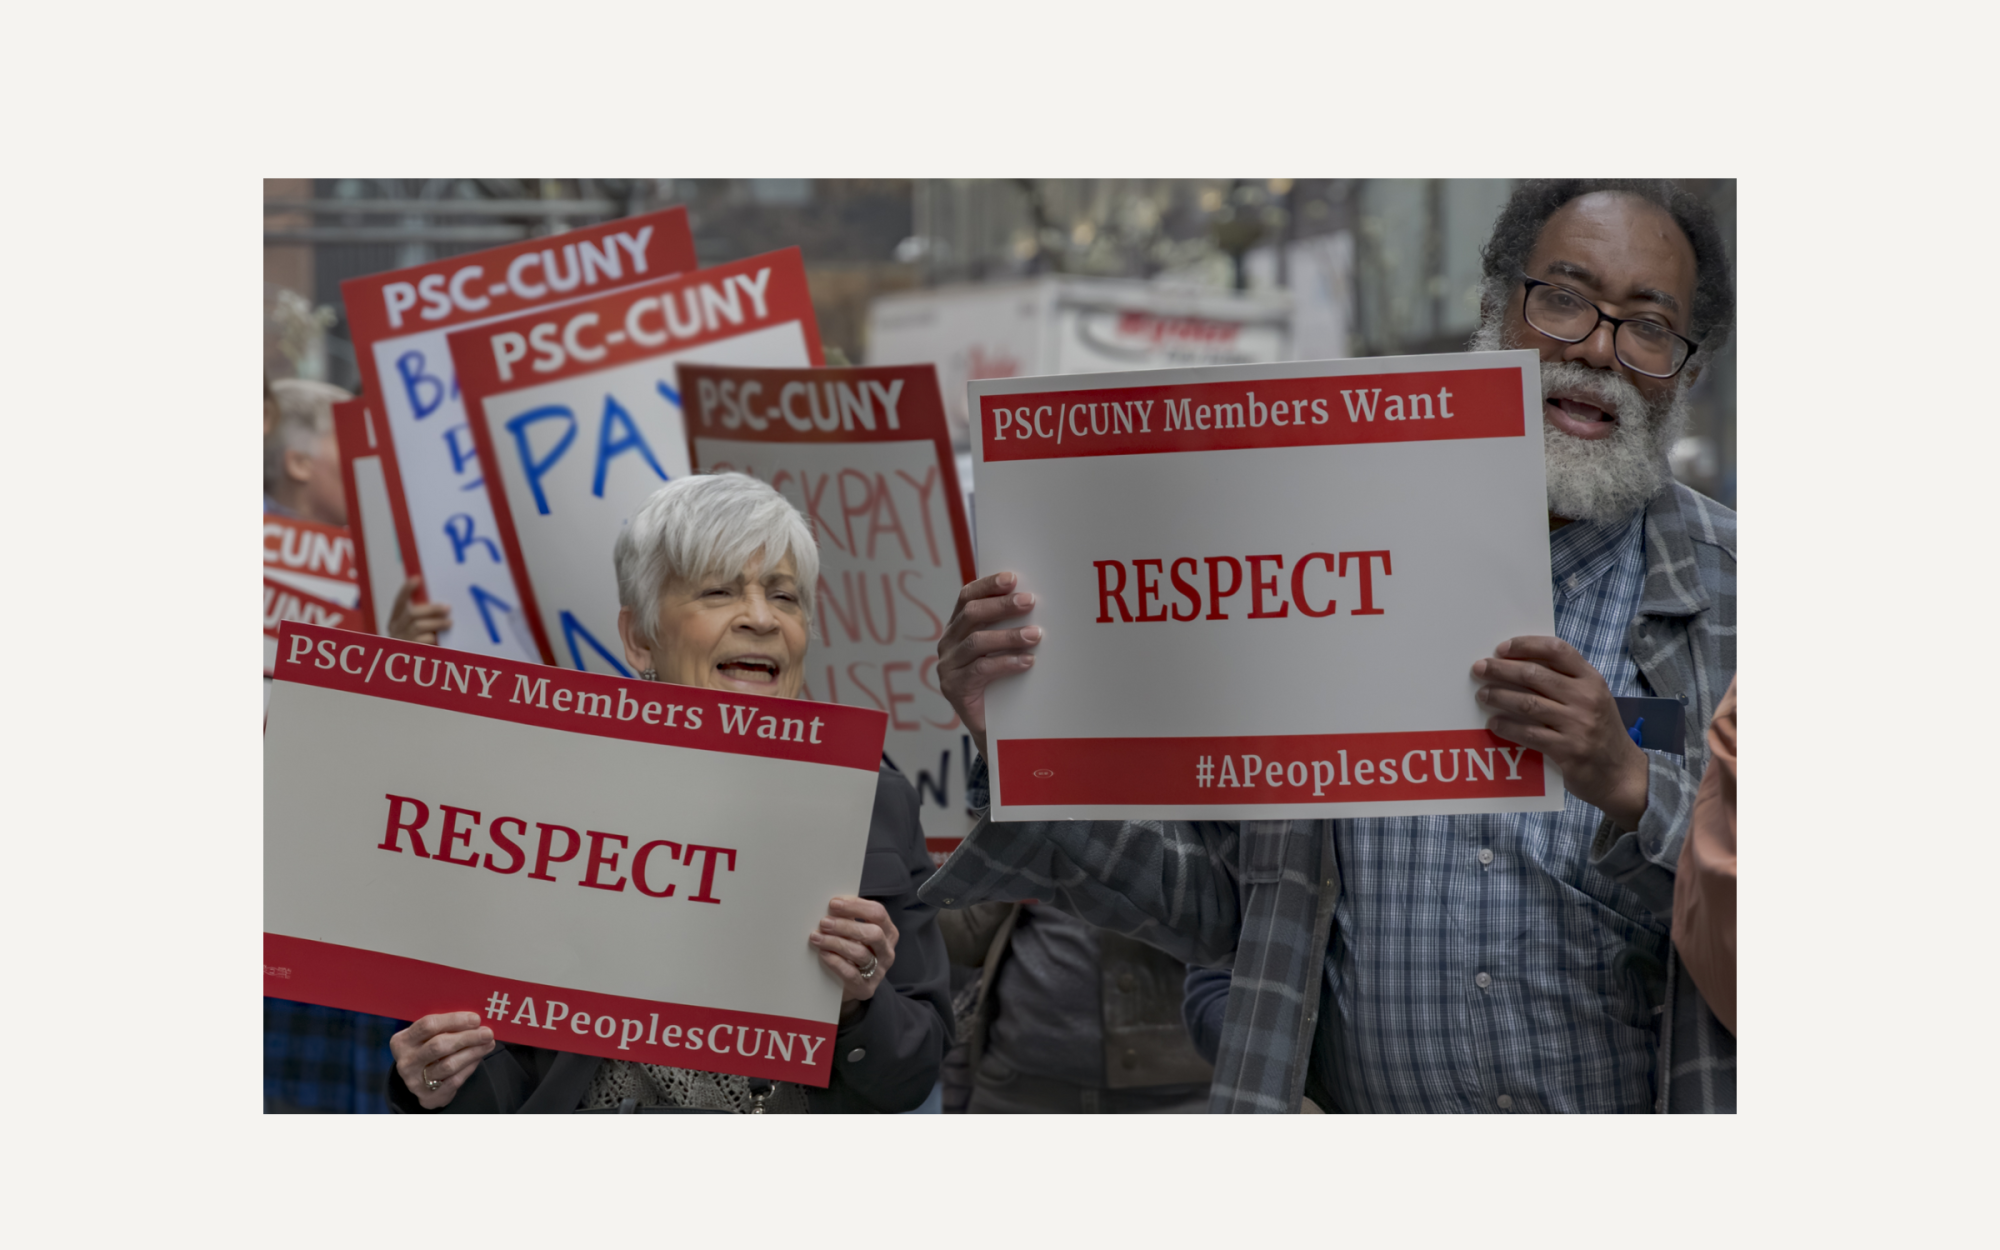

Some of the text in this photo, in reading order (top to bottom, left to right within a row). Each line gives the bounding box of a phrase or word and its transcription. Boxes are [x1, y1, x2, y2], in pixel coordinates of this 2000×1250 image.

[382, 224, 654, 330] PSC-CUNY
[490, 267, 772, 382] PSC-CUNY
[696, 379, 905, 433] PSC-CUNY
[992, 386, 1455, 444] PSC/CUNY Members Want
[1093, 550, 1392, 623] RESPECT
[286, 634, 502, 699] PSC/CUNY
[509, 673, 705, 731] Members
[717, 702, 826, 746] Want
[1196, 747, 1527, 796] #APeoplesCUNY
[377, 793, 738, 905] RESPECT
[484, 990, 826, 1067] #APeoplesCUNY
